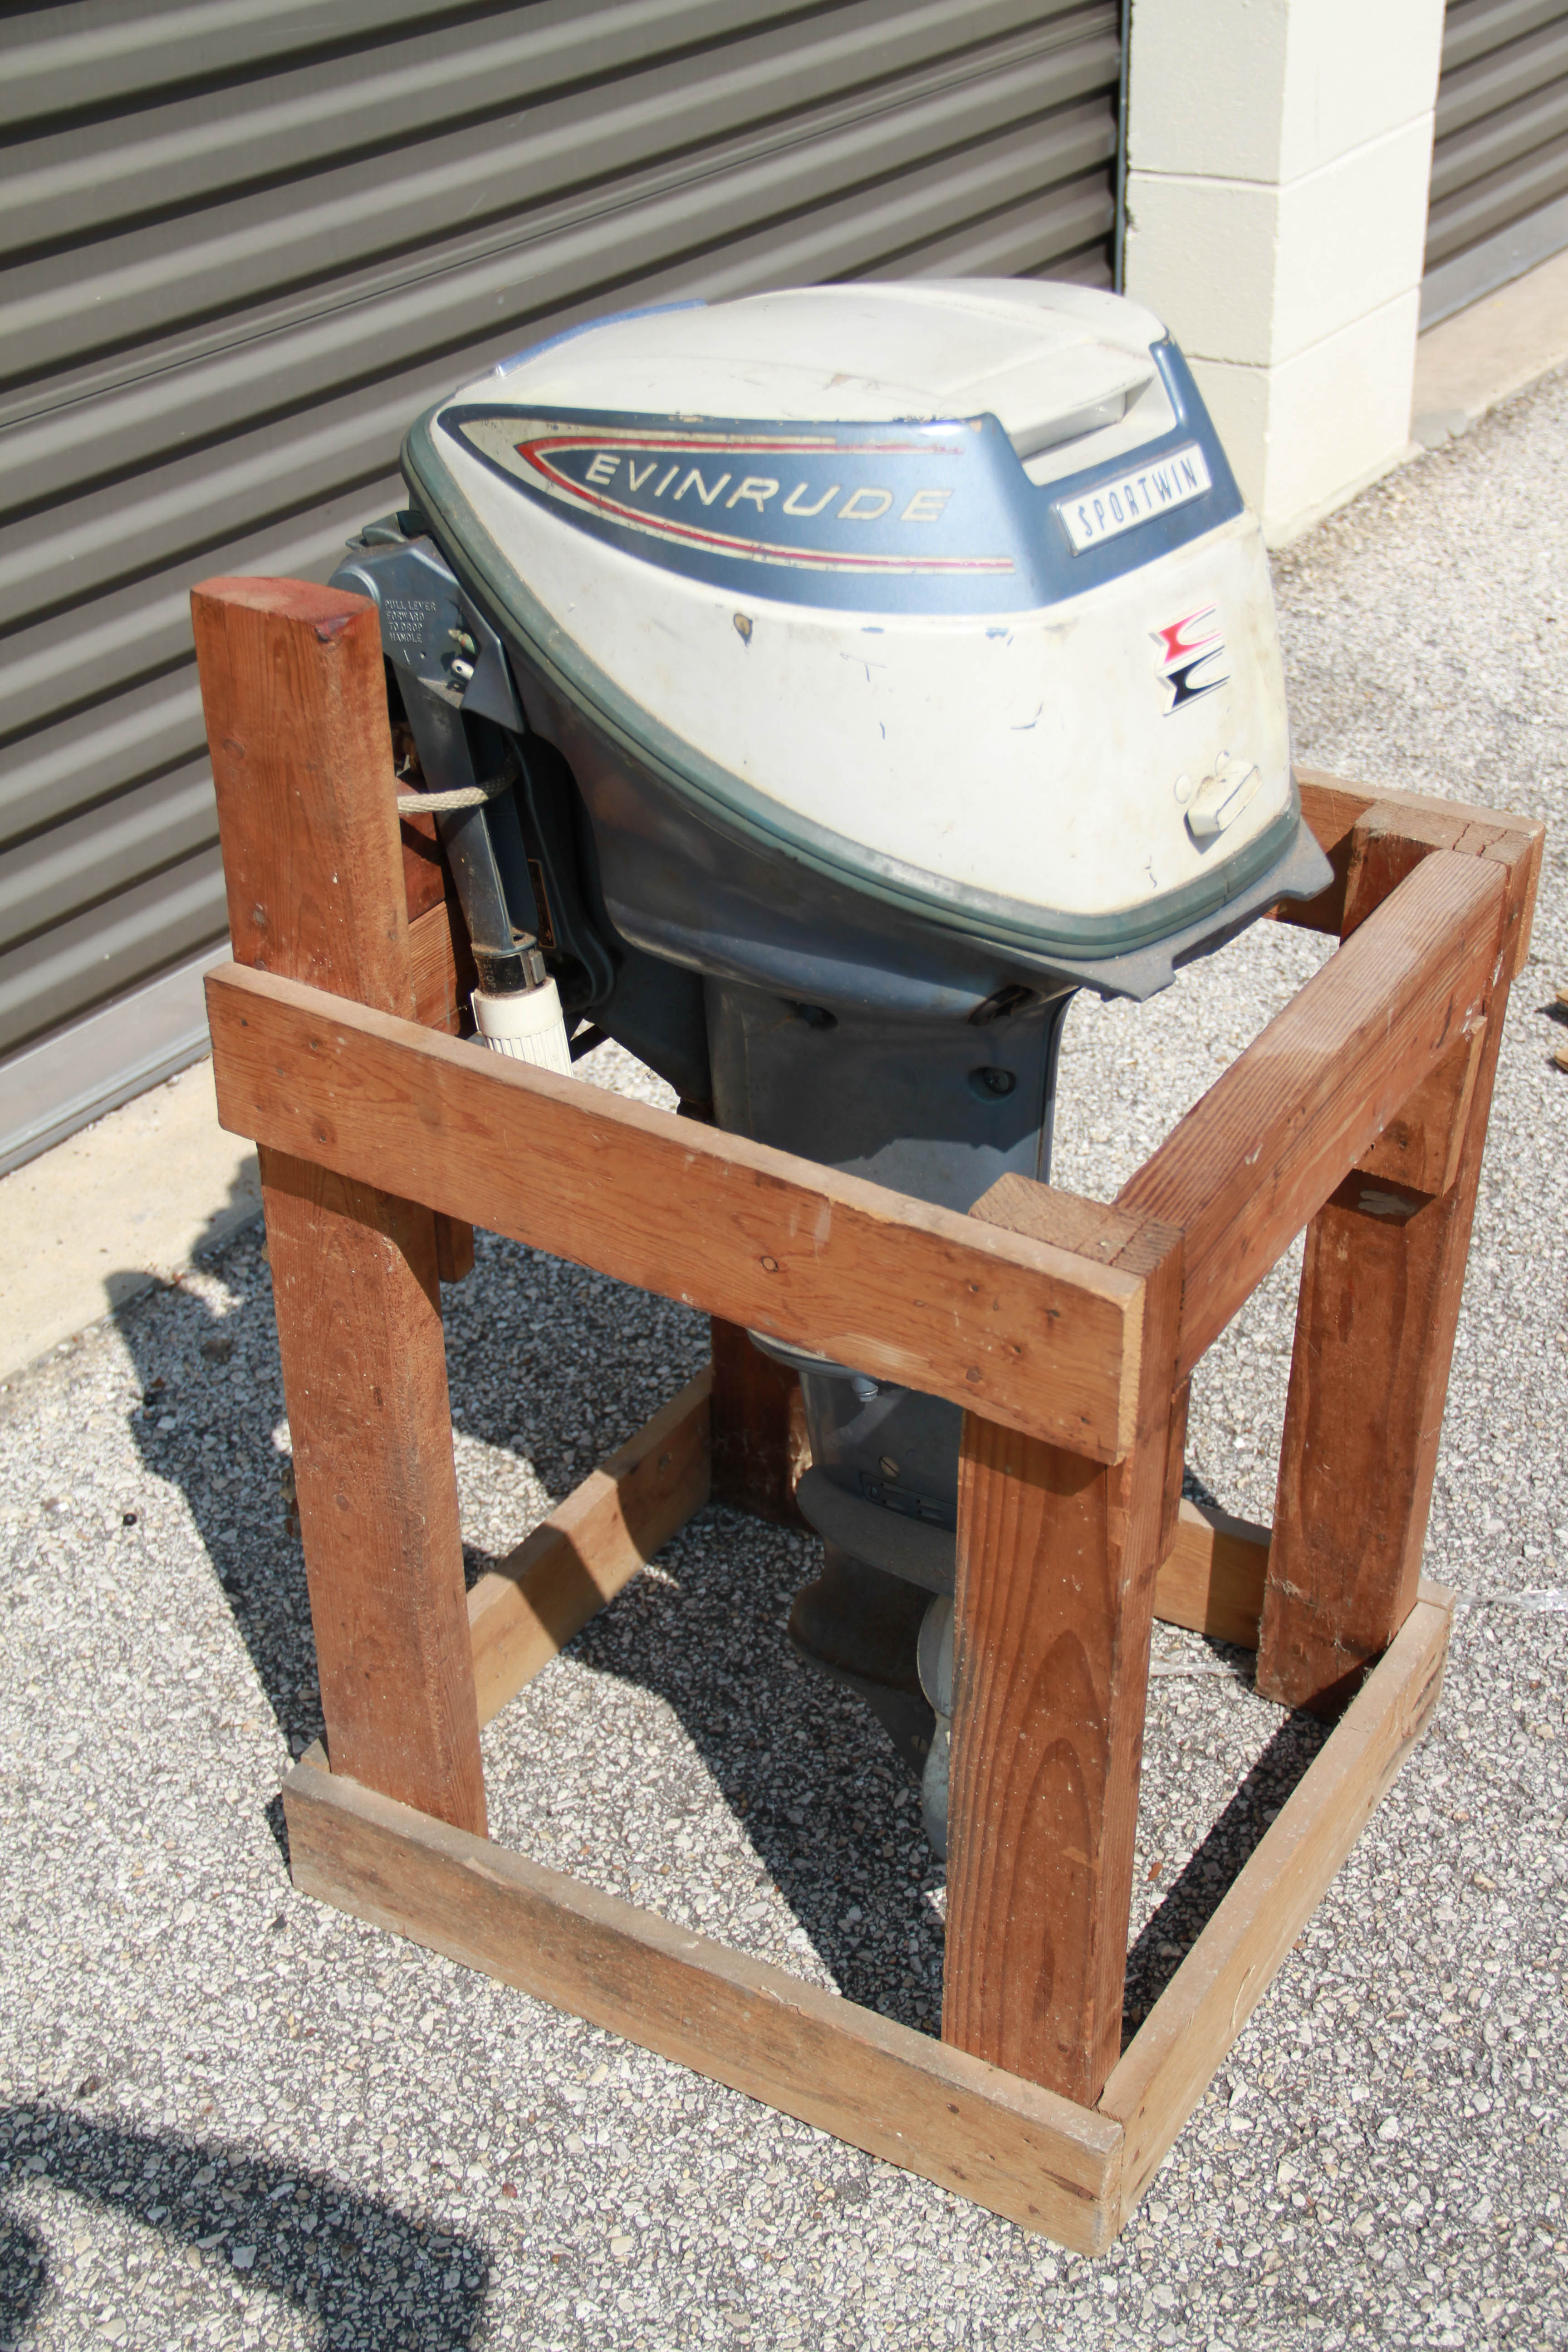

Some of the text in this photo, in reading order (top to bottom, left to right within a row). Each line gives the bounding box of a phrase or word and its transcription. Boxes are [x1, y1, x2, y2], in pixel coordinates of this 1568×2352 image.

[585, 453, 954, 522] EVINRUDE
[1077, 457, 1198, 536] SPORTWIN
[385, 599, 436, 612] PULL LEVER
[387, 611, 425, 622] FORWARD
[388, 622, 423, 632] TO DROP
[389, 632, 422, 643] HANDLE
